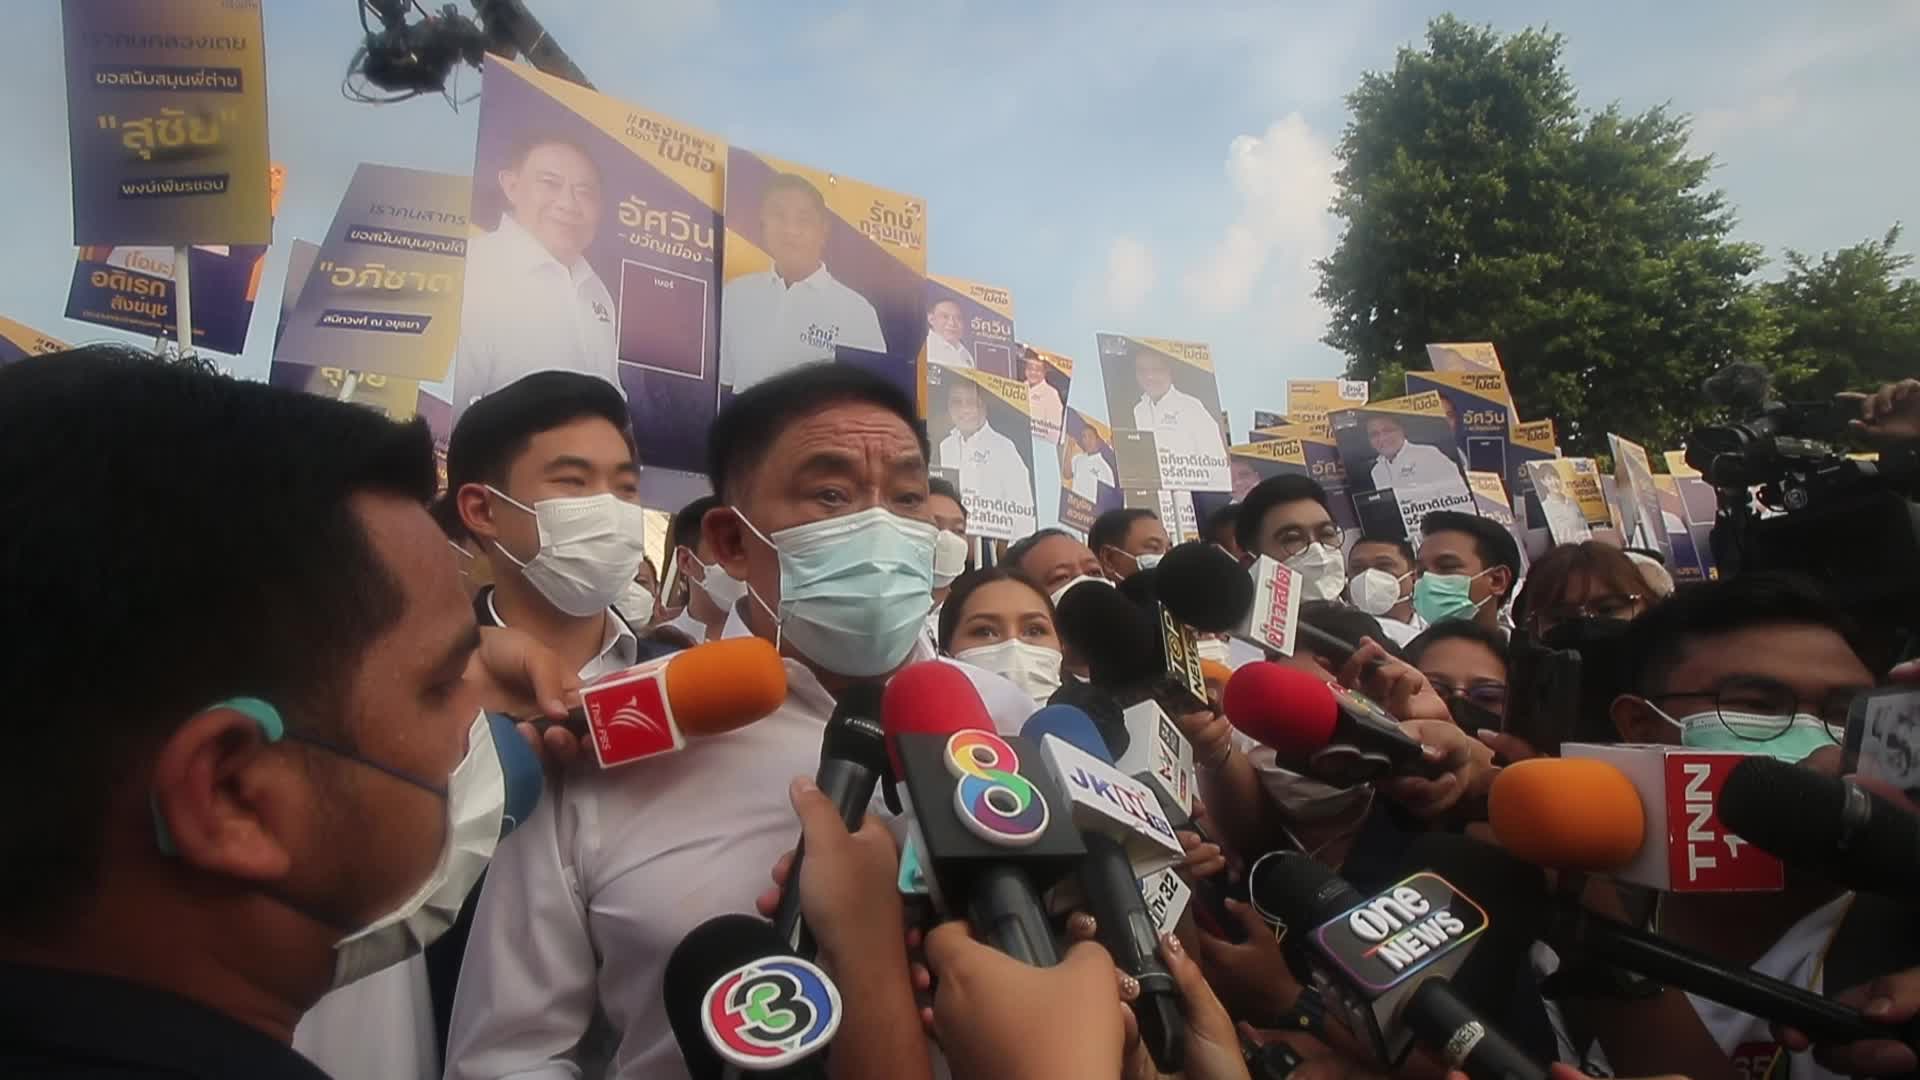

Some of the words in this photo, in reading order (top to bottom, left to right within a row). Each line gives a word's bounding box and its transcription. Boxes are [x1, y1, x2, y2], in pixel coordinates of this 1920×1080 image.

[657, 138, 716, 173] ไปต่อ
[618, 195, 715, 250] อัศวิน
[1260, 563, 1293, 650] ข่าวสด
[1684, 763, 1717, 881] TNN
[1377, 911, 1465, 971] NEWS
